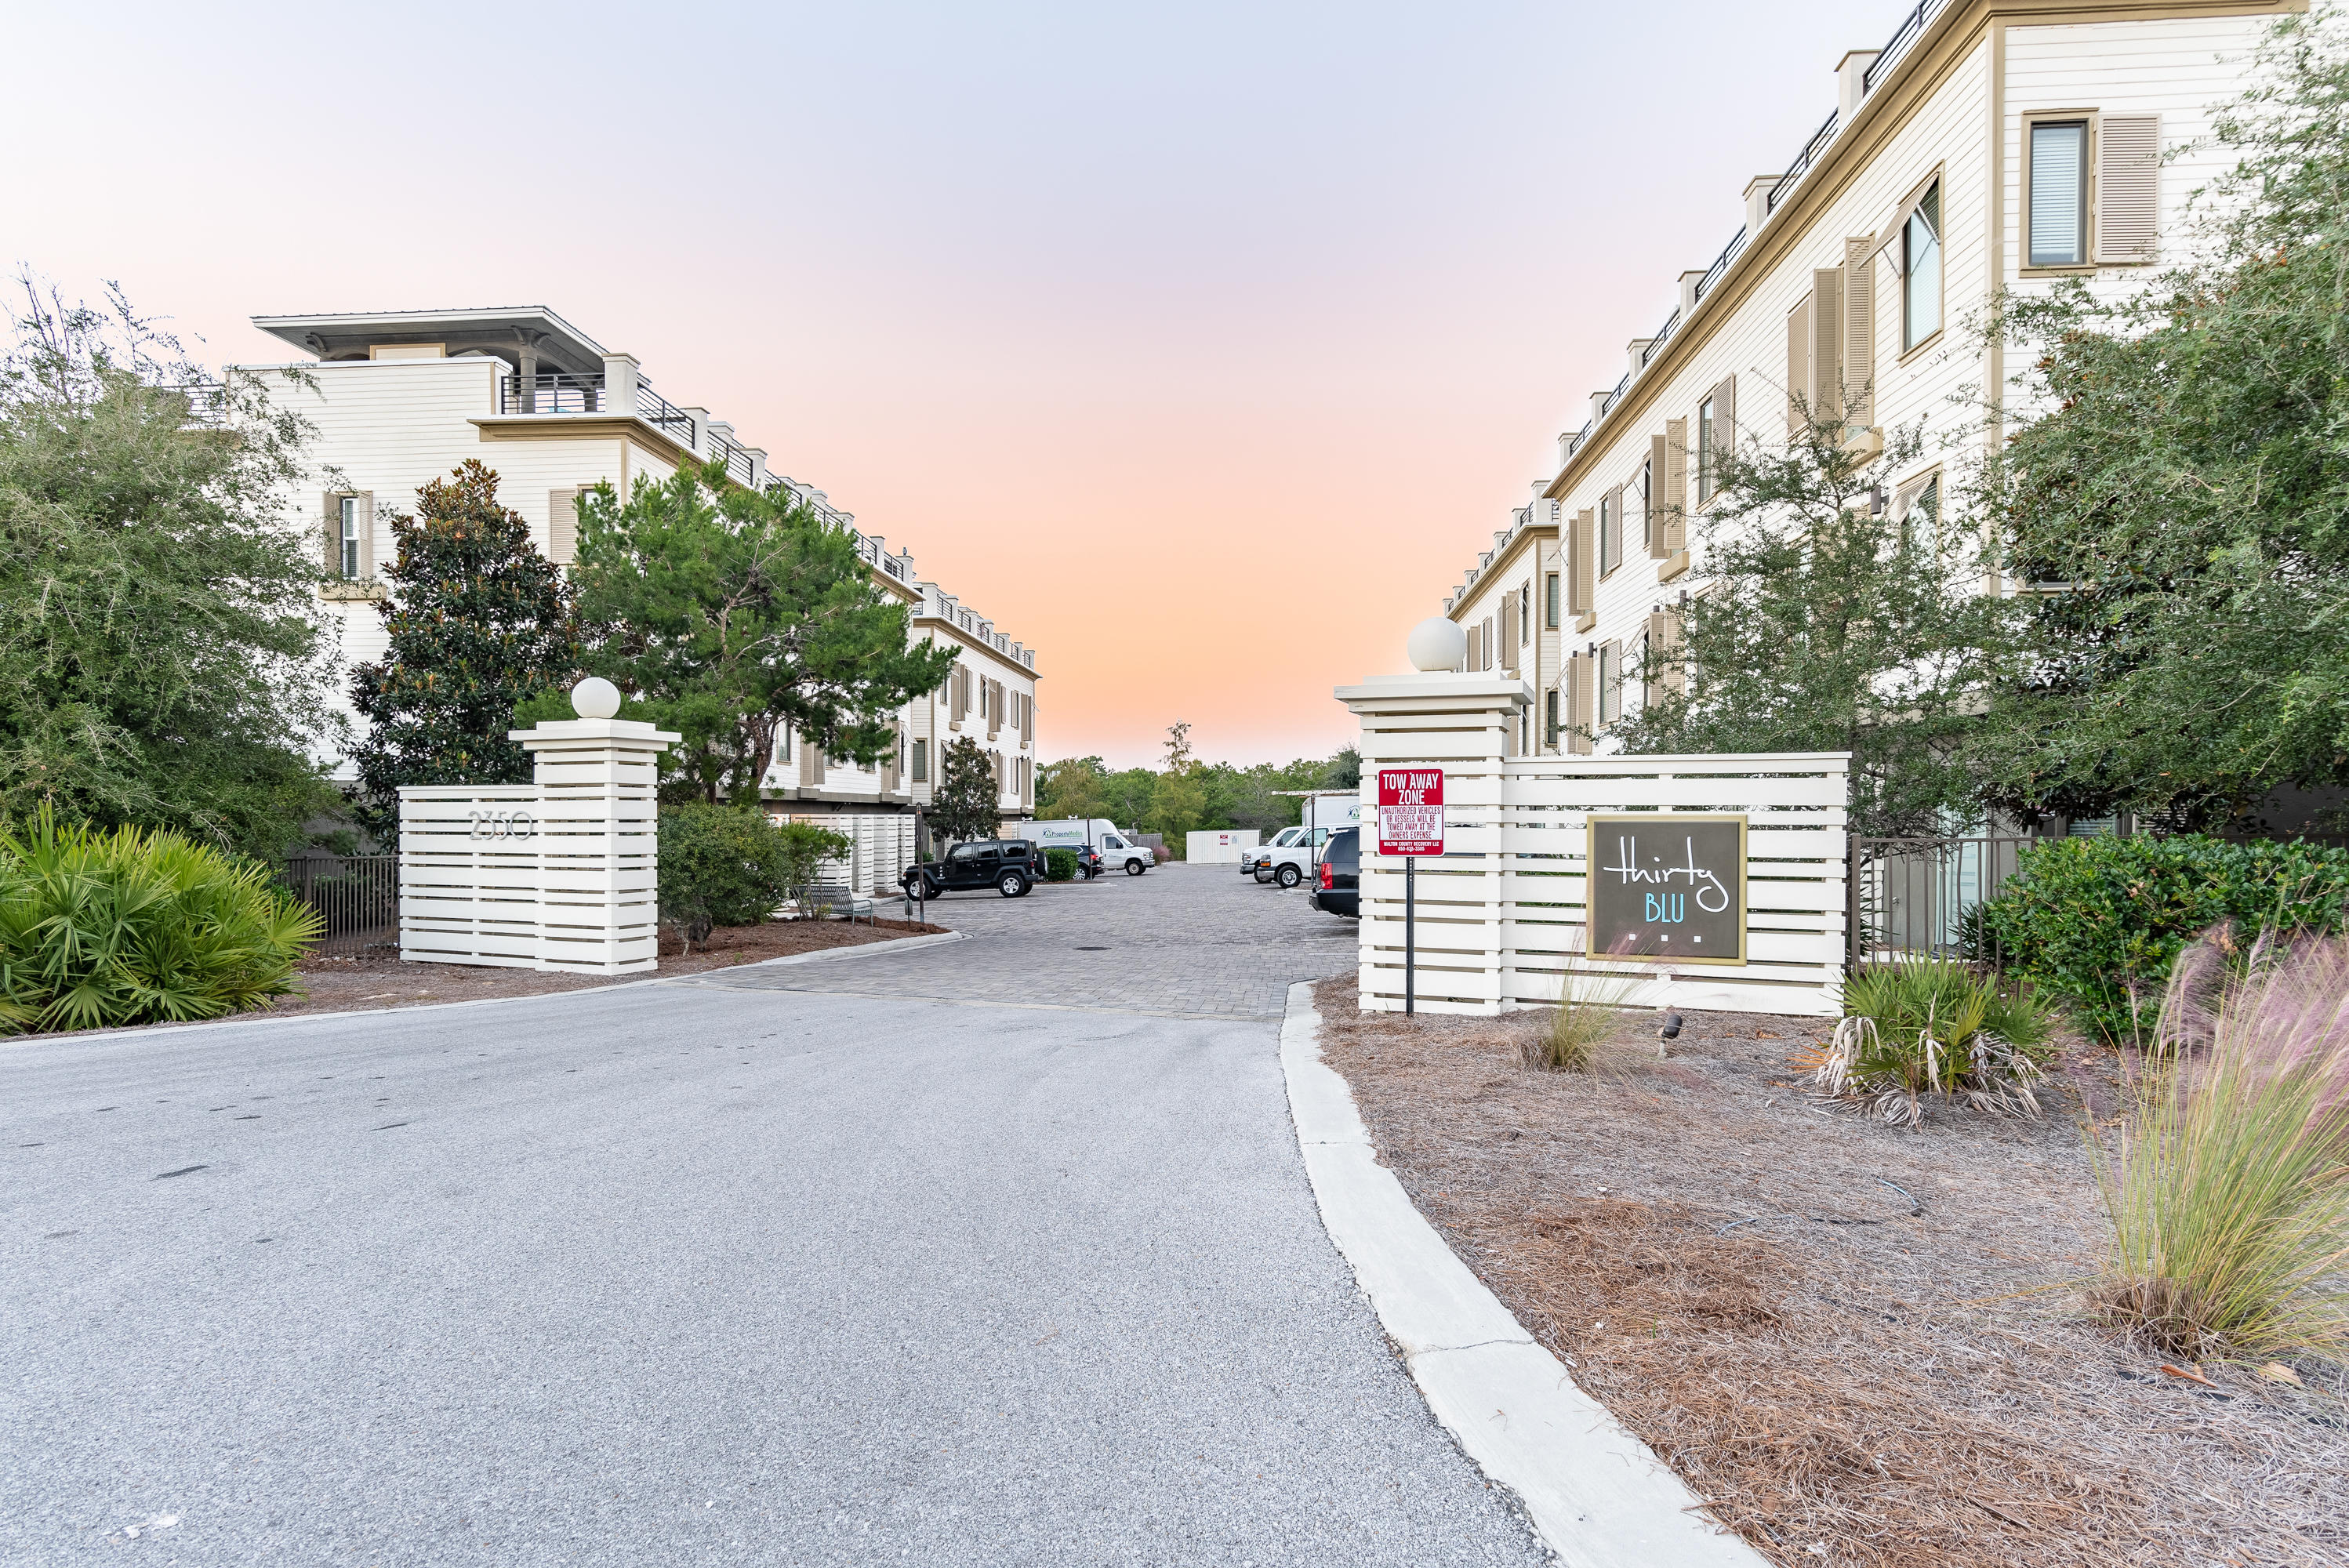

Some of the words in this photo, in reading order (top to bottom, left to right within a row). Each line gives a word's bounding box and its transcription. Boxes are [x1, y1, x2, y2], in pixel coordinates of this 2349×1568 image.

[1383, 774, 1407, 789] TOW
[1409, 773, 1439, 789] AWAY
[1398, 789, 1425, 804] ZONE
[1418, 806, 1441, 815] VEHICLES
[468, 811, 533, 840] 2350
[1386, 815, 1393, 823] OR
[1395, 815, 1415, 823] VESSELS
[1389, 831, 1409, 840] OWNERS
[1603, 836, 1730, 913] thirty
[1646, 892, 1684, 924] BLU
